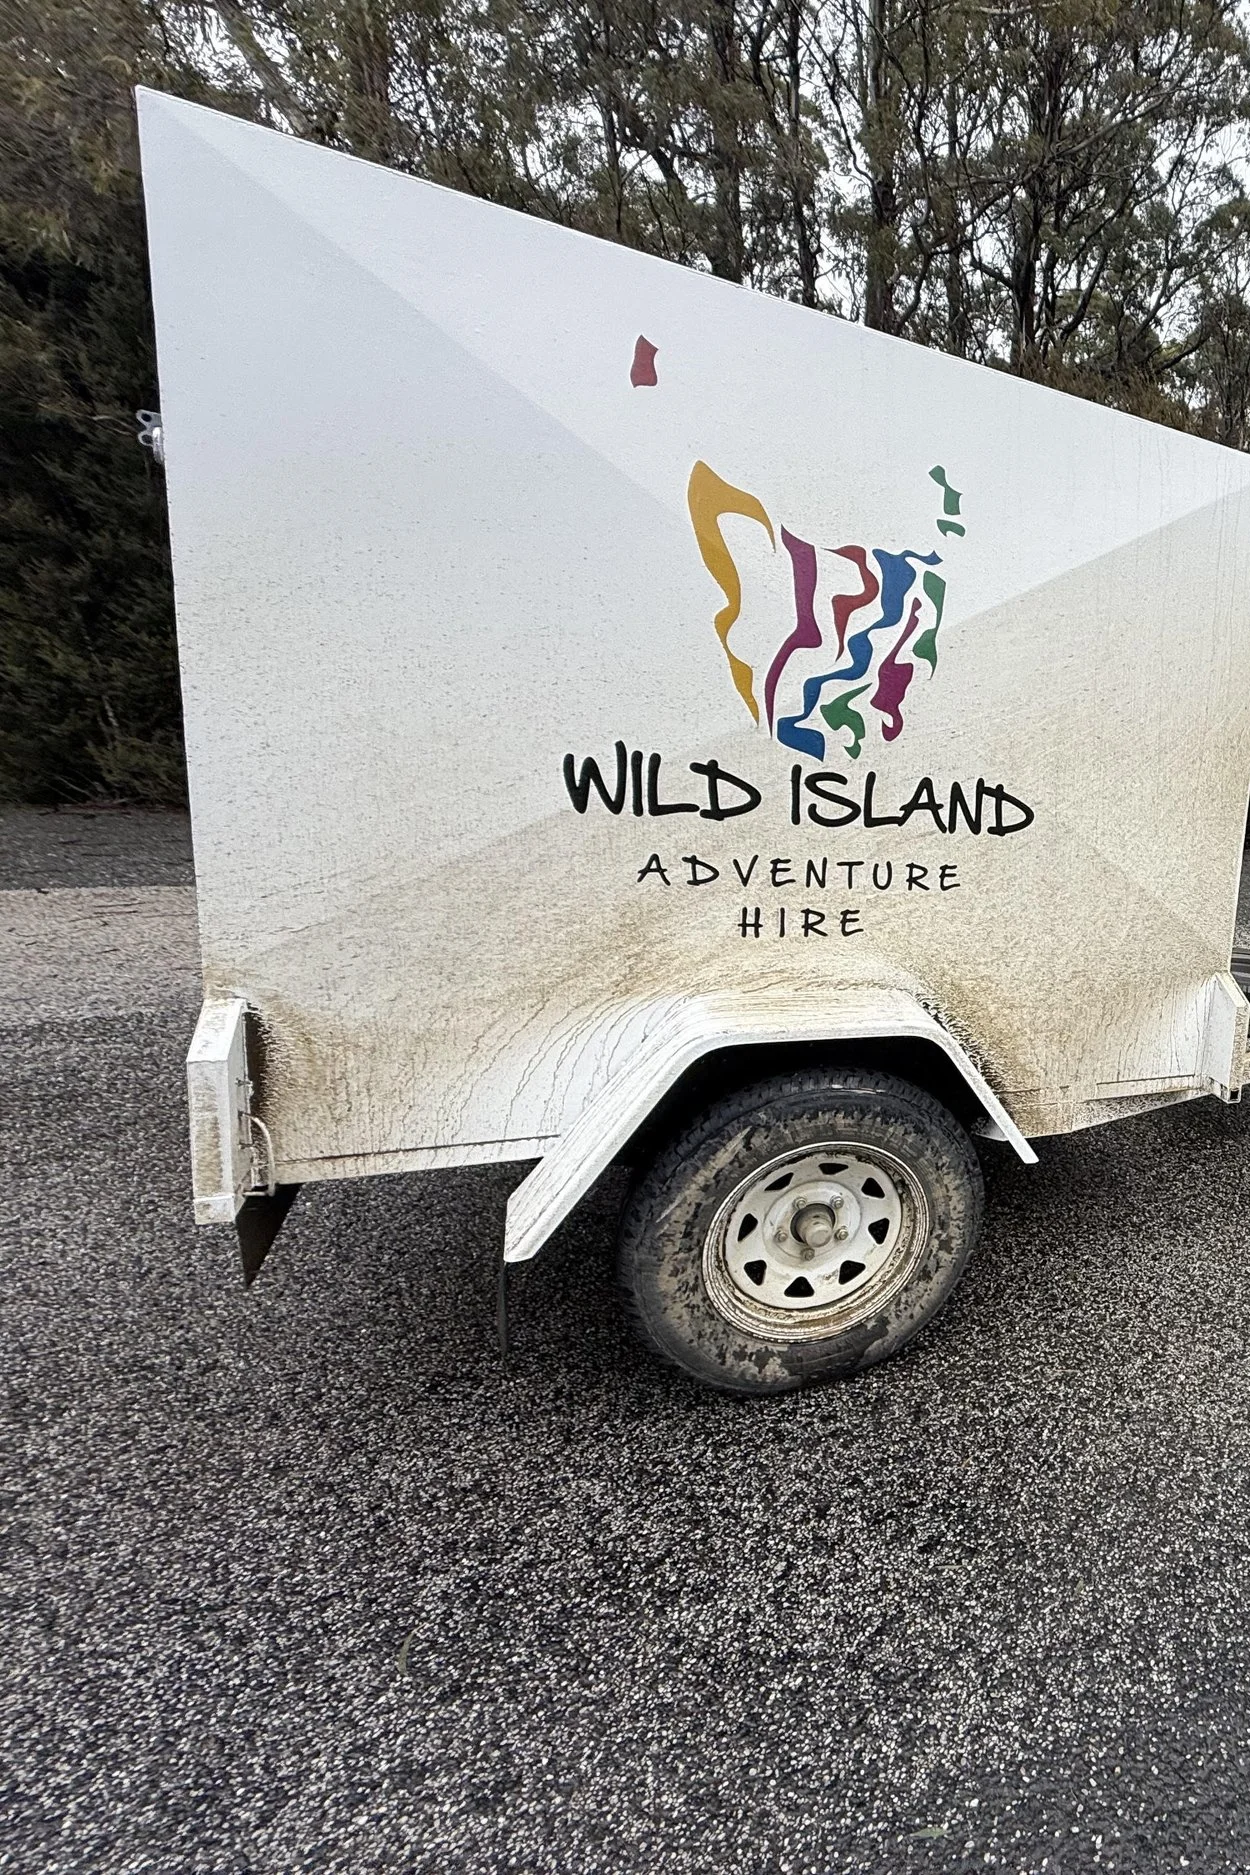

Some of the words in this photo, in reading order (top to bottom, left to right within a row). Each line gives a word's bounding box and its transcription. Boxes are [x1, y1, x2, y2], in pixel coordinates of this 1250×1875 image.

[562, 740, 762, 821] WILD
[790, 764, 1035, 837] ISLAND
[637, 852, 960, 892] ADVENTURE
[737, 906, 865, 939] HIRE
